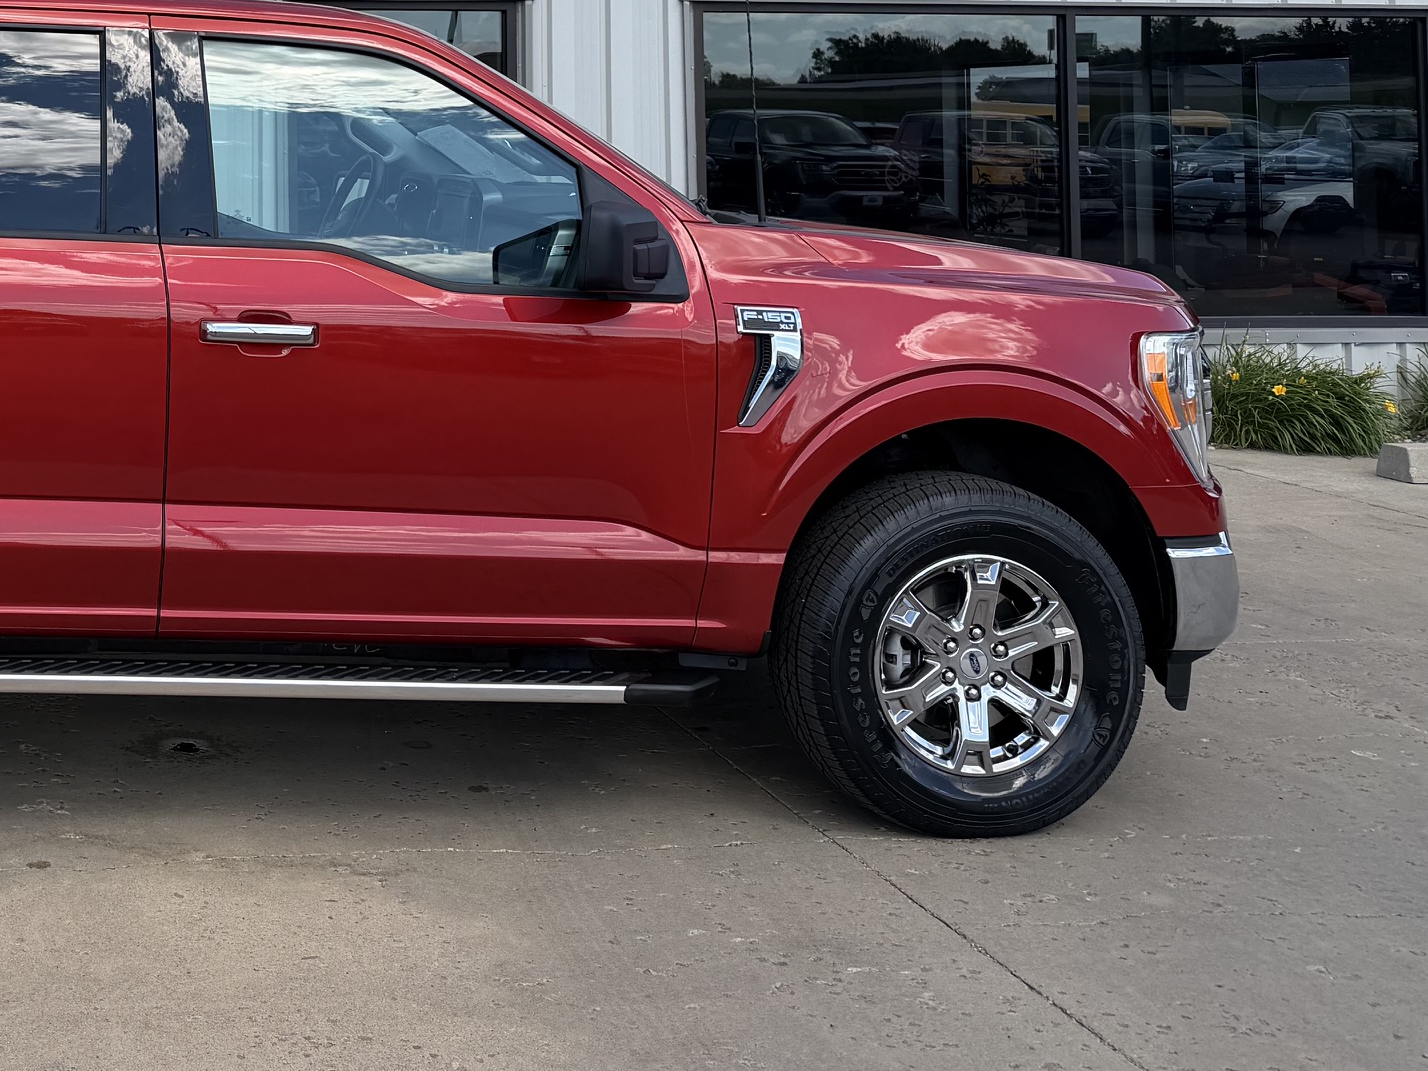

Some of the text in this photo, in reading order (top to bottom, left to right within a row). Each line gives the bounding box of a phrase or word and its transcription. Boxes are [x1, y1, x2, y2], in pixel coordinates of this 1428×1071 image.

[742, 310, 796, 323] F-150
[847, 627, 894, 769] Firestone
[1075, 567, 1124, 707] Firestone
